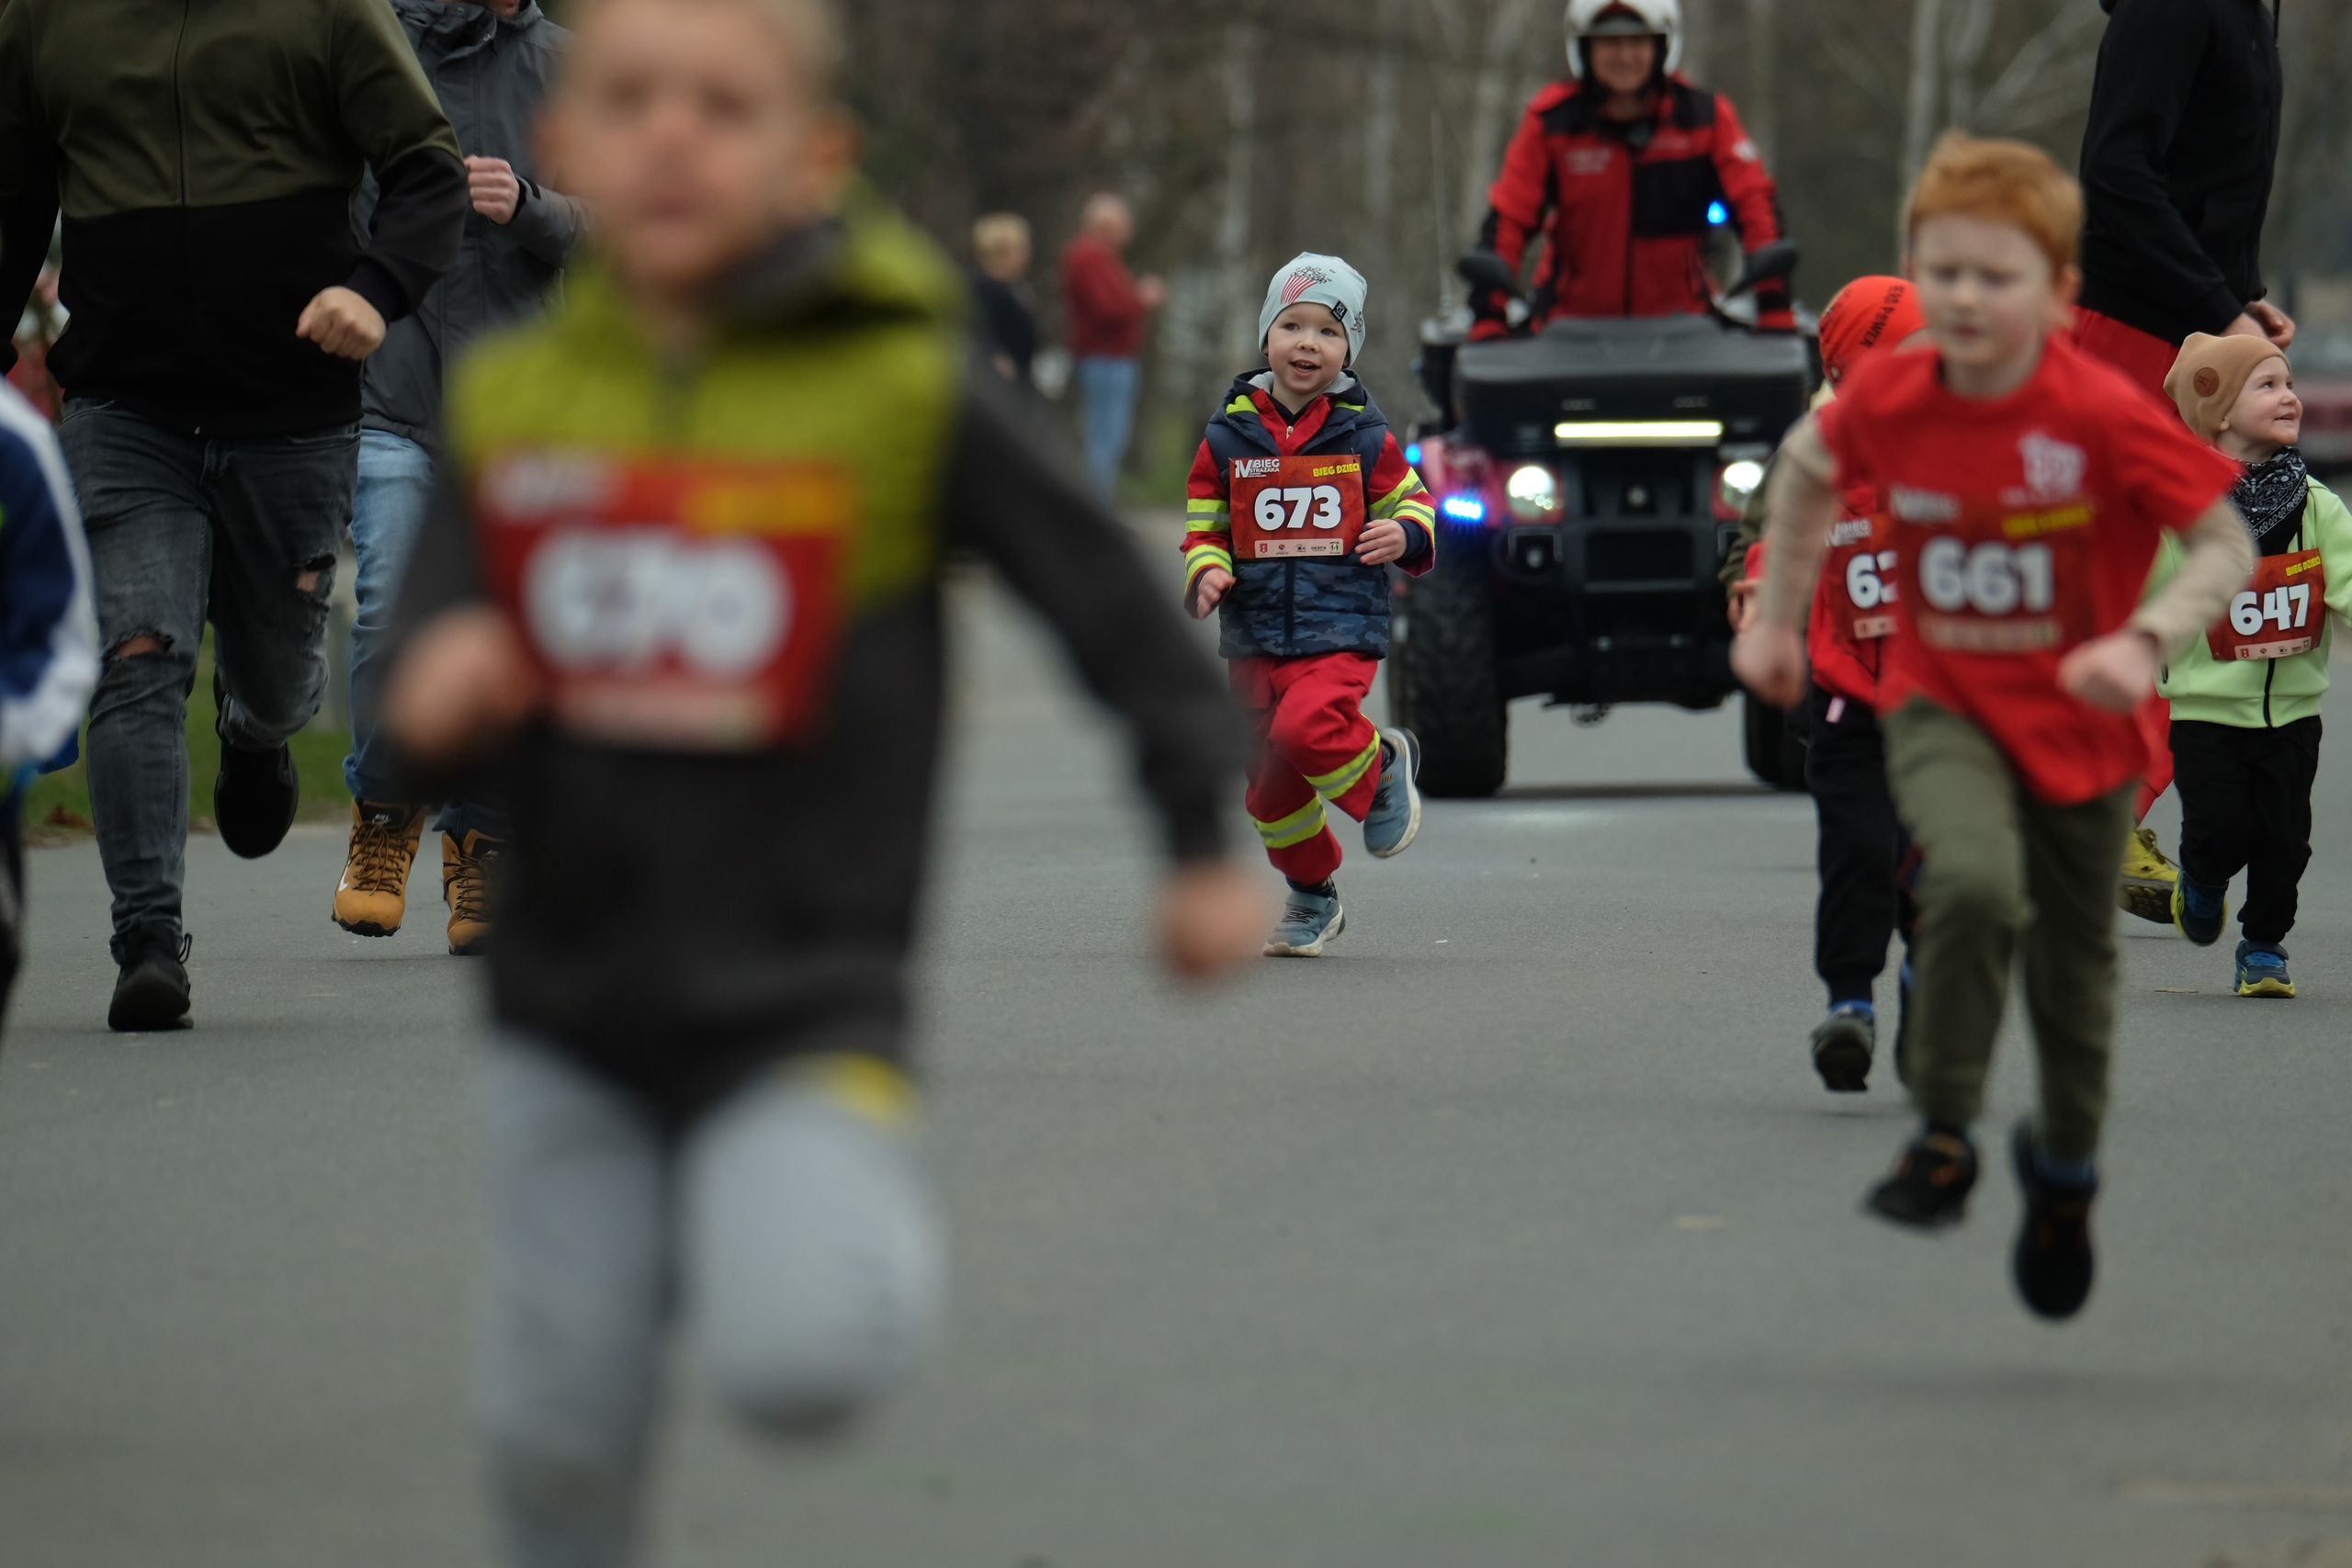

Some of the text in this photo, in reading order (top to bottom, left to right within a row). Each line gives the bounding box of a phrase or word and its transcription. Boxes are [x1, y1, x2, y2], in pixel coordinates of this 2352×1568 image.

[1860, 306, 1894, 348] POWER
[1252, 458, 1280, 468] BIEG
[1313, 463, 1360, 477] BIEG DZIECI
[1254, 485, 1341, 530] 673
[1919, 537, 2053, 614] 661
[2286, 556, 2322, 576] BIEG DZIECI
[2230, 583, 2310, 636] 647
